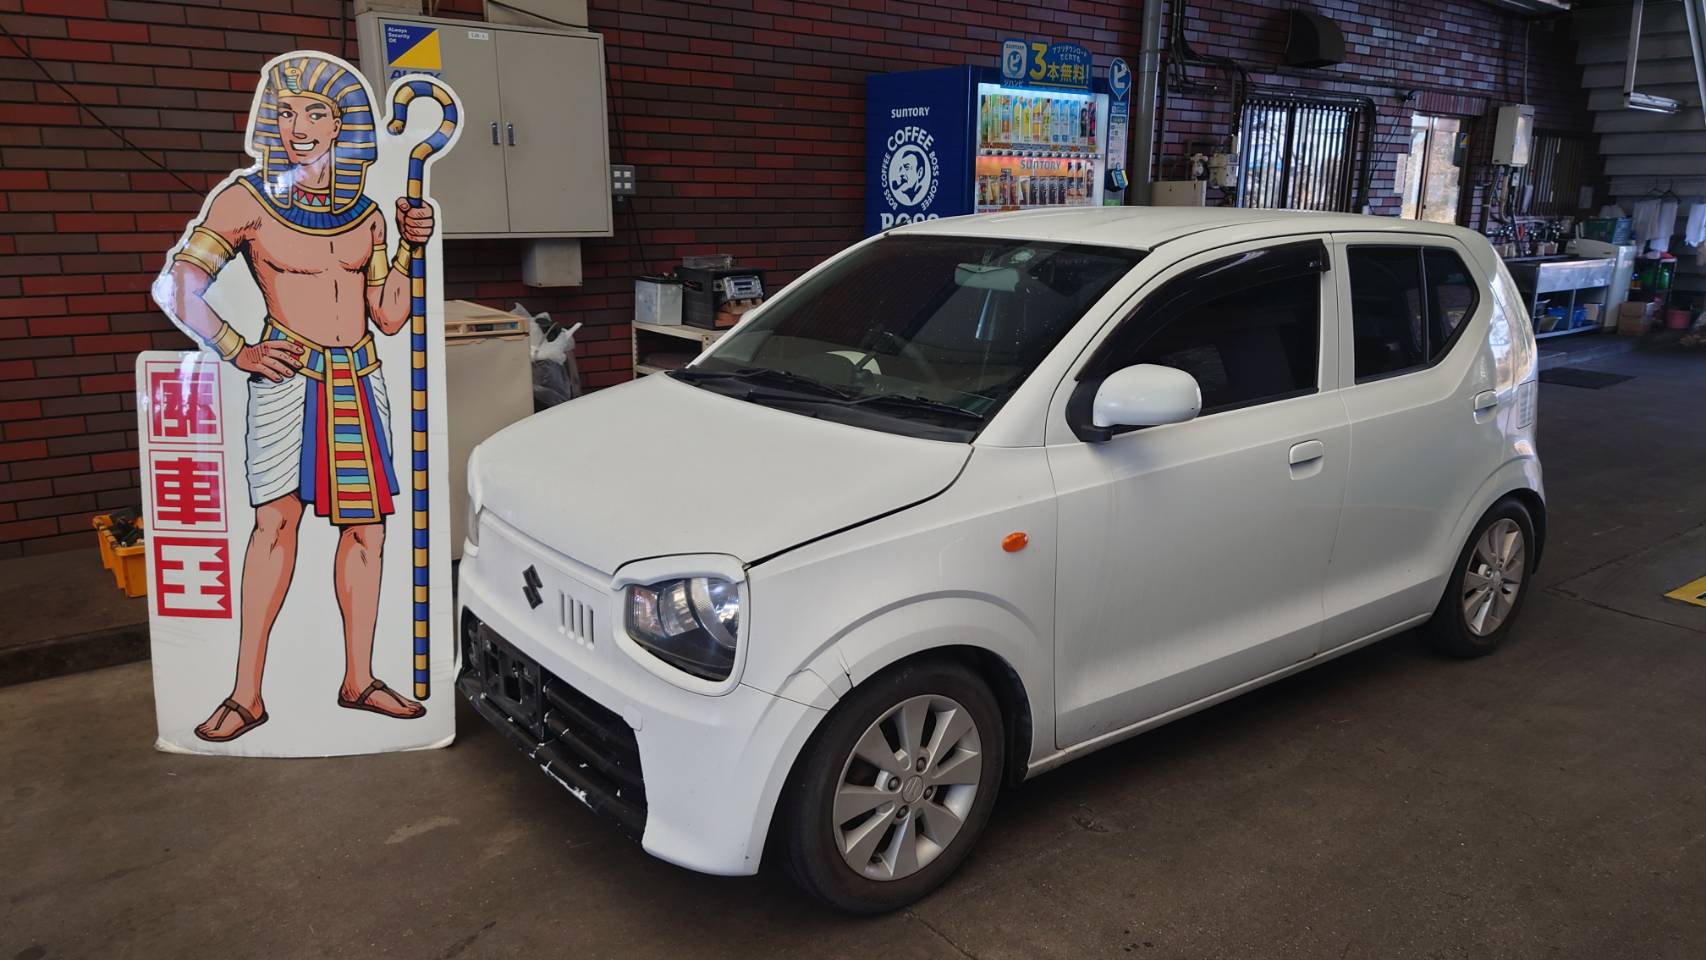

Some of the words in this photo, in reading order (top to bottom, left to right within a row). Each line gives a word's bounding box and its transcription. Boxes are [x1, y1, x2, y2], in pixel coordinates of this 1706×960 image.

[891, 106, 930, 118] SUNTORY
[887, 126, 934, 151] COFFEE
[881, 152, 892, 187] COFFEE
[928, 150, 939, 177] BOSS
[1020, 159, 1061, 171] SUNTORY
[884, 189, 898, 210] BOSS
[920, 179, 939, 211] COFFEE
